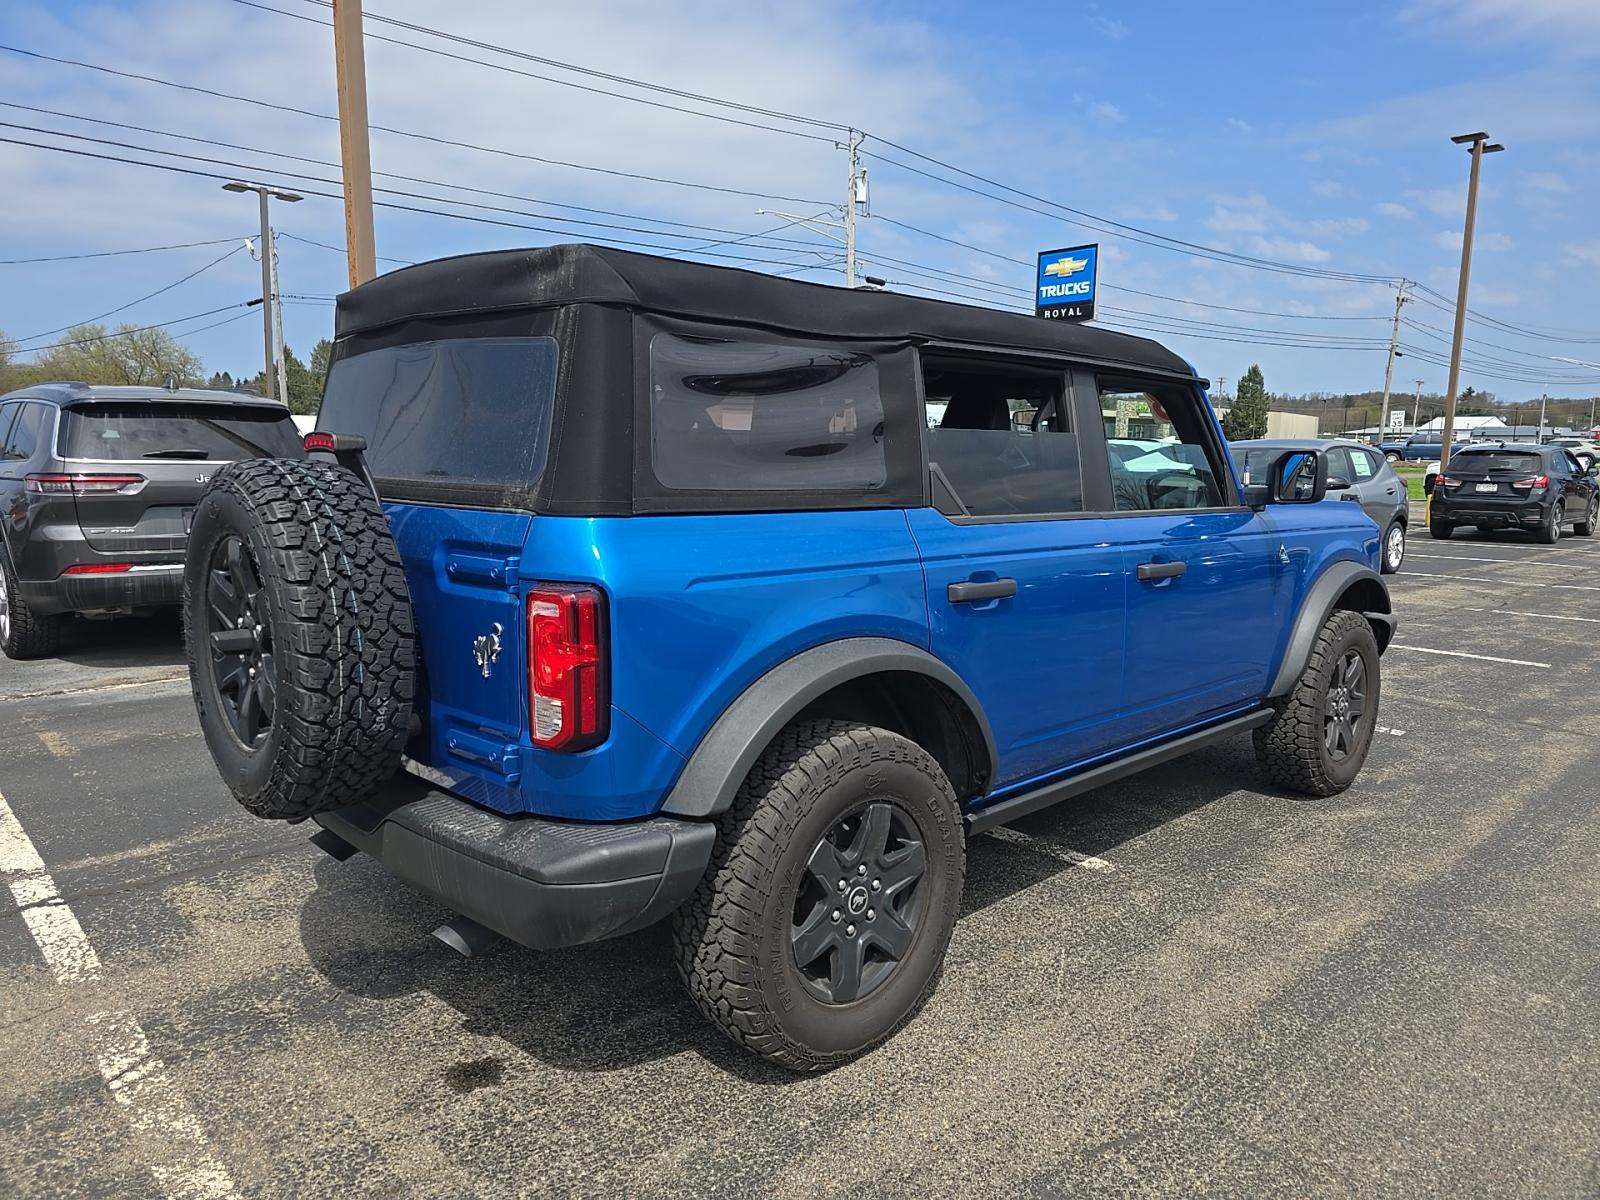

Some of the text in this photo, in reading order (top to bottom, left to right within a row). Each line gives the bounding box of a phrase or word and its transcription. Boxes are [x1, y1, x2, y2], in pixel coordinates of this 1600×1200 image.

[1040, 281, 1090, 298] TRUCKS
[1044, 307, 1082, 319] ROYAL
[196, 473, 212, 483] Je
